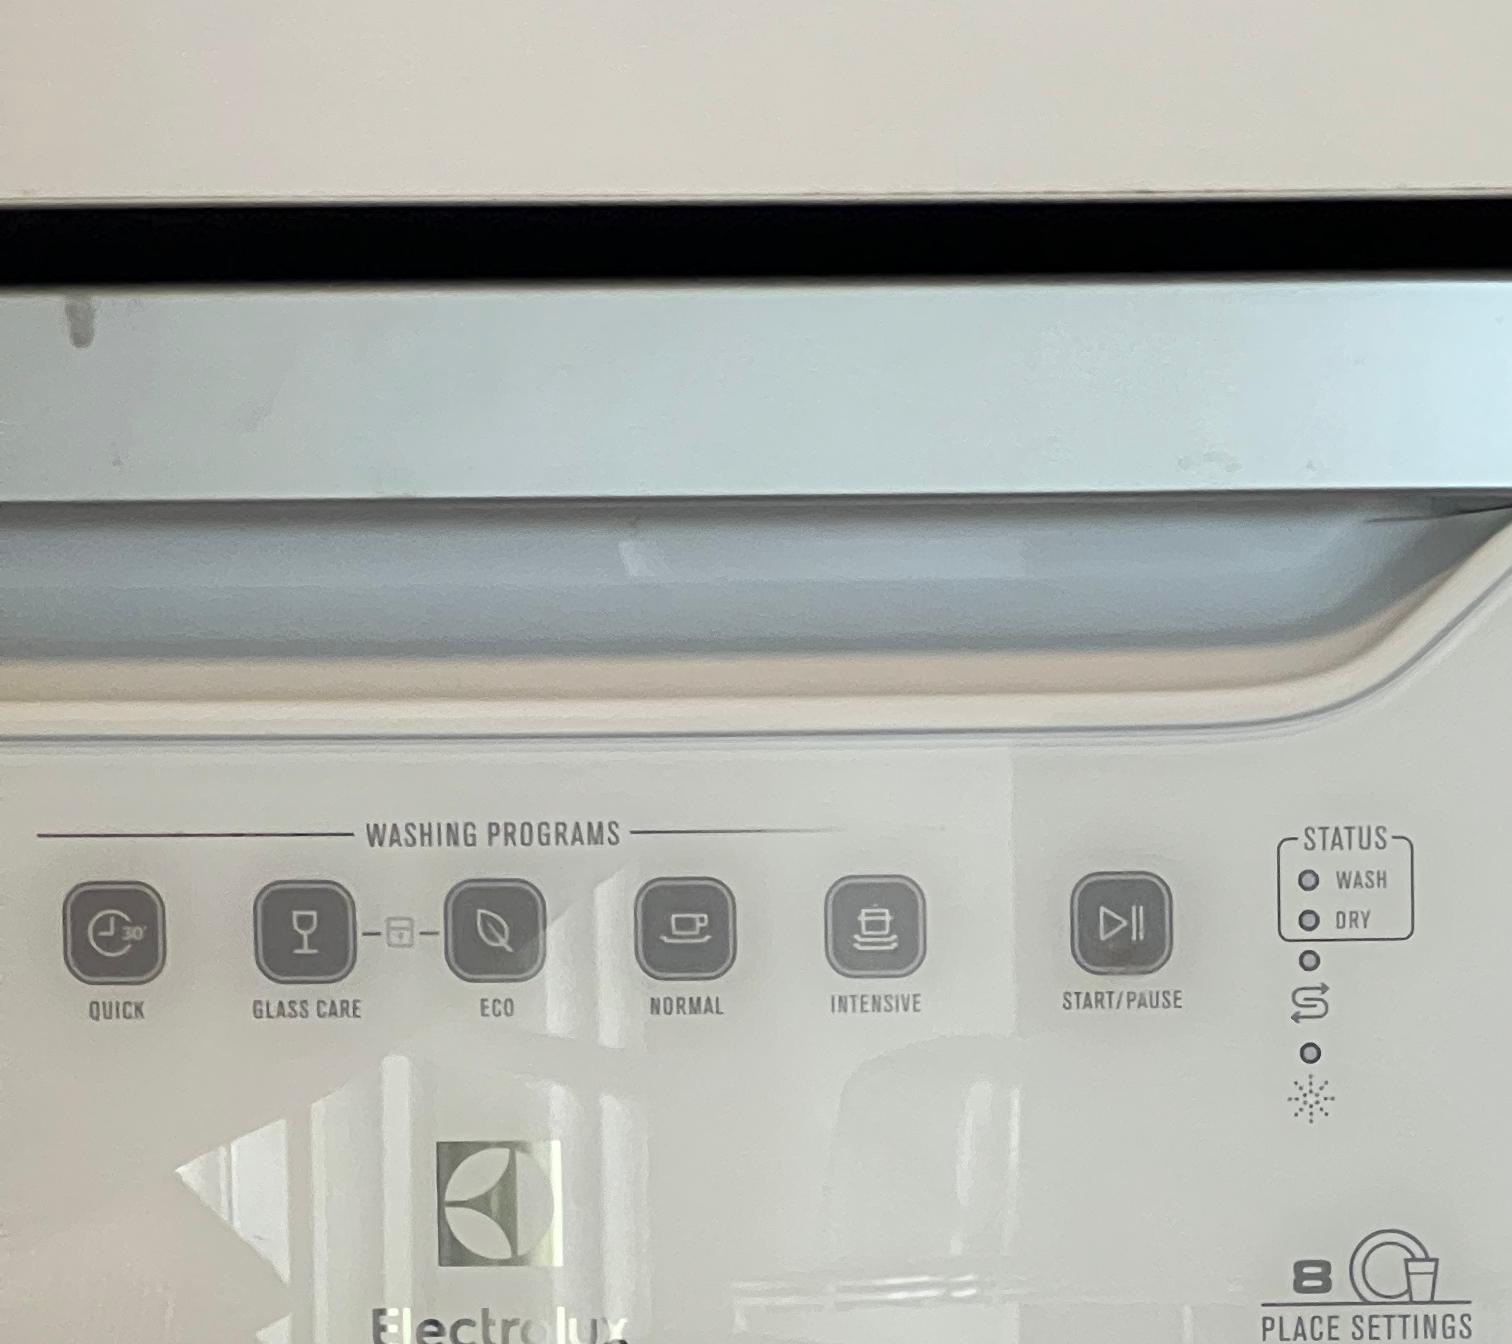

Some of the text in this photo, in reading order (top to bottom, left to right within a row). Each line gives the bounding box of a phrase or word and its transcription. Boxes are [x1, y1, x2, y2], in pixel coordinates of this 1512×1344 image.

[365, 820, 620, 848] WASHING PROGRAMS
[1303, 824, 1388, 852] STATUS
[1335, 869, 1387, 890] WASH
[1335, 909, 1371, 930] DRY
[88, 1000, 145, 1022] QUICK
[252, 998, 362, 1020] GLASS CARE
[479, 997, 515, 1018] ECO
[649, 995, 725, 1016] NORMAL
[830, 992, 922, 1014] INTENSIVE
[1062, 989, 1183, 1011] START/PAUSE
[1292, 1259, 1333, 1295] 8
[1261, 1312, 1473, 1342] PLACE SETTINGS
